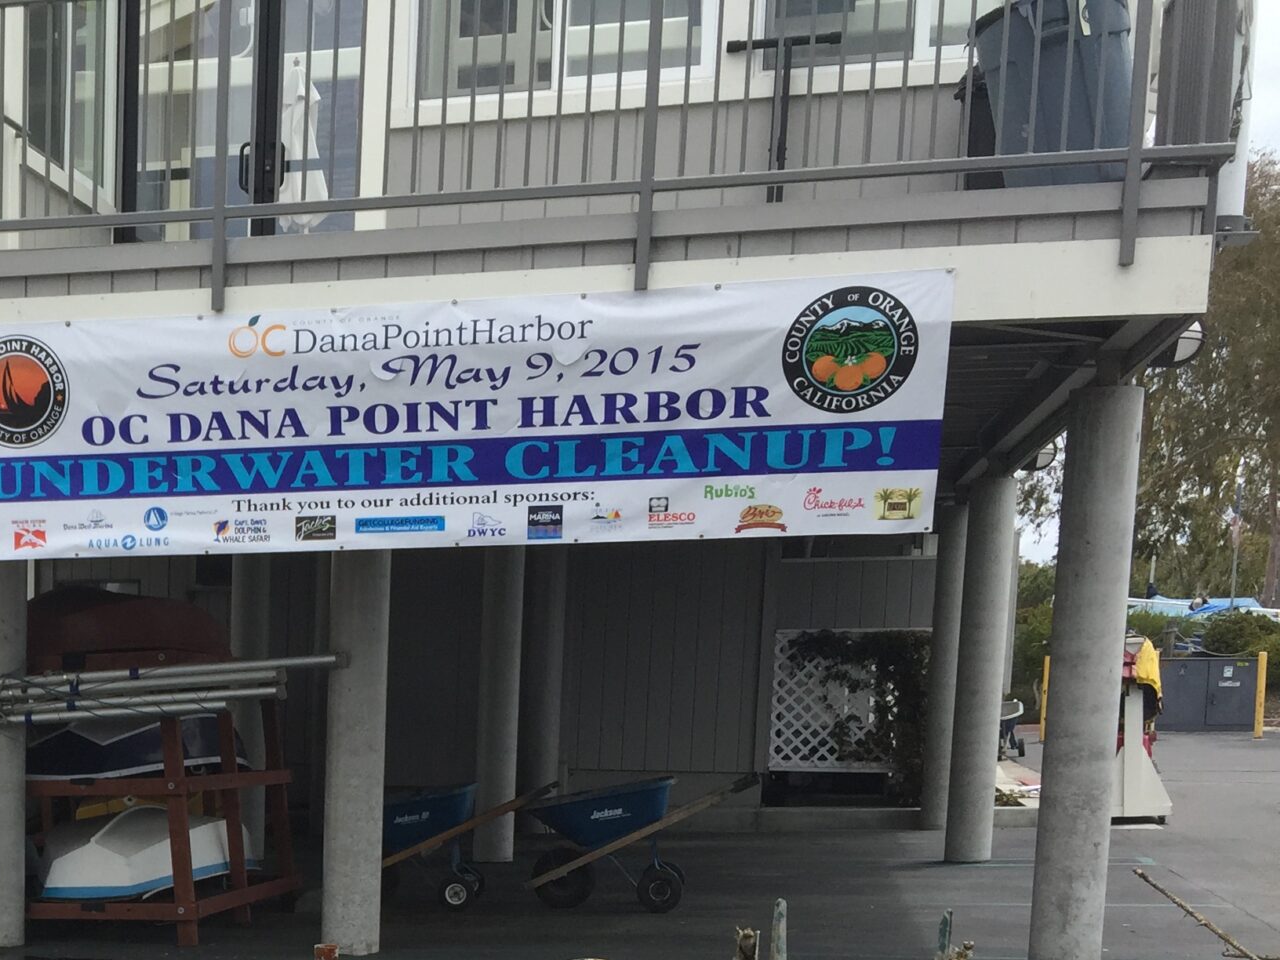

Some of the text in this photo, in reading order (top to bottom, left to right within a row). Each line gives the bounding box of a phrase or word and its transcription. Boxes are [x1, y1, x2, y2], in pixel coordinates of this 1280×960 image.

[228, 314, 594, 358] OC DanaPointHarbor
[785, 291, 915, 363] COUNTY OF ORANGE
[30, 344, 64, 391] HARBOR
[136, 343, 702, 400] Saturday, May 9, 2015
[793, 374, 905, 411] CALIFORNIA
[13, 434, 28, 443] OF
[29, 404, 63, 440] ORANGE
[81, 385, 772, 447] OC DANA POINT HARBOR
[505, 426, 898, 480] CLEANUP!
[231, 497, 293, 513] Thank
[297, 500, 331, 515] you
[337, 497, 356, 510] to
[361, 498, 394, 509] our
[399, 490, 498, 508] additional
[504, 490, 596, 508] sponsors:
[704, 484, 756, 499] Rubio's
[467, 527, 506, 538] DWYC
[529, 512, 561, 521] MARINA
[648, 512, 696, 523] ELESCO
[88, 536, 170, 550] AQUA LUNG
[222, 535, 246, 543] WHALE
